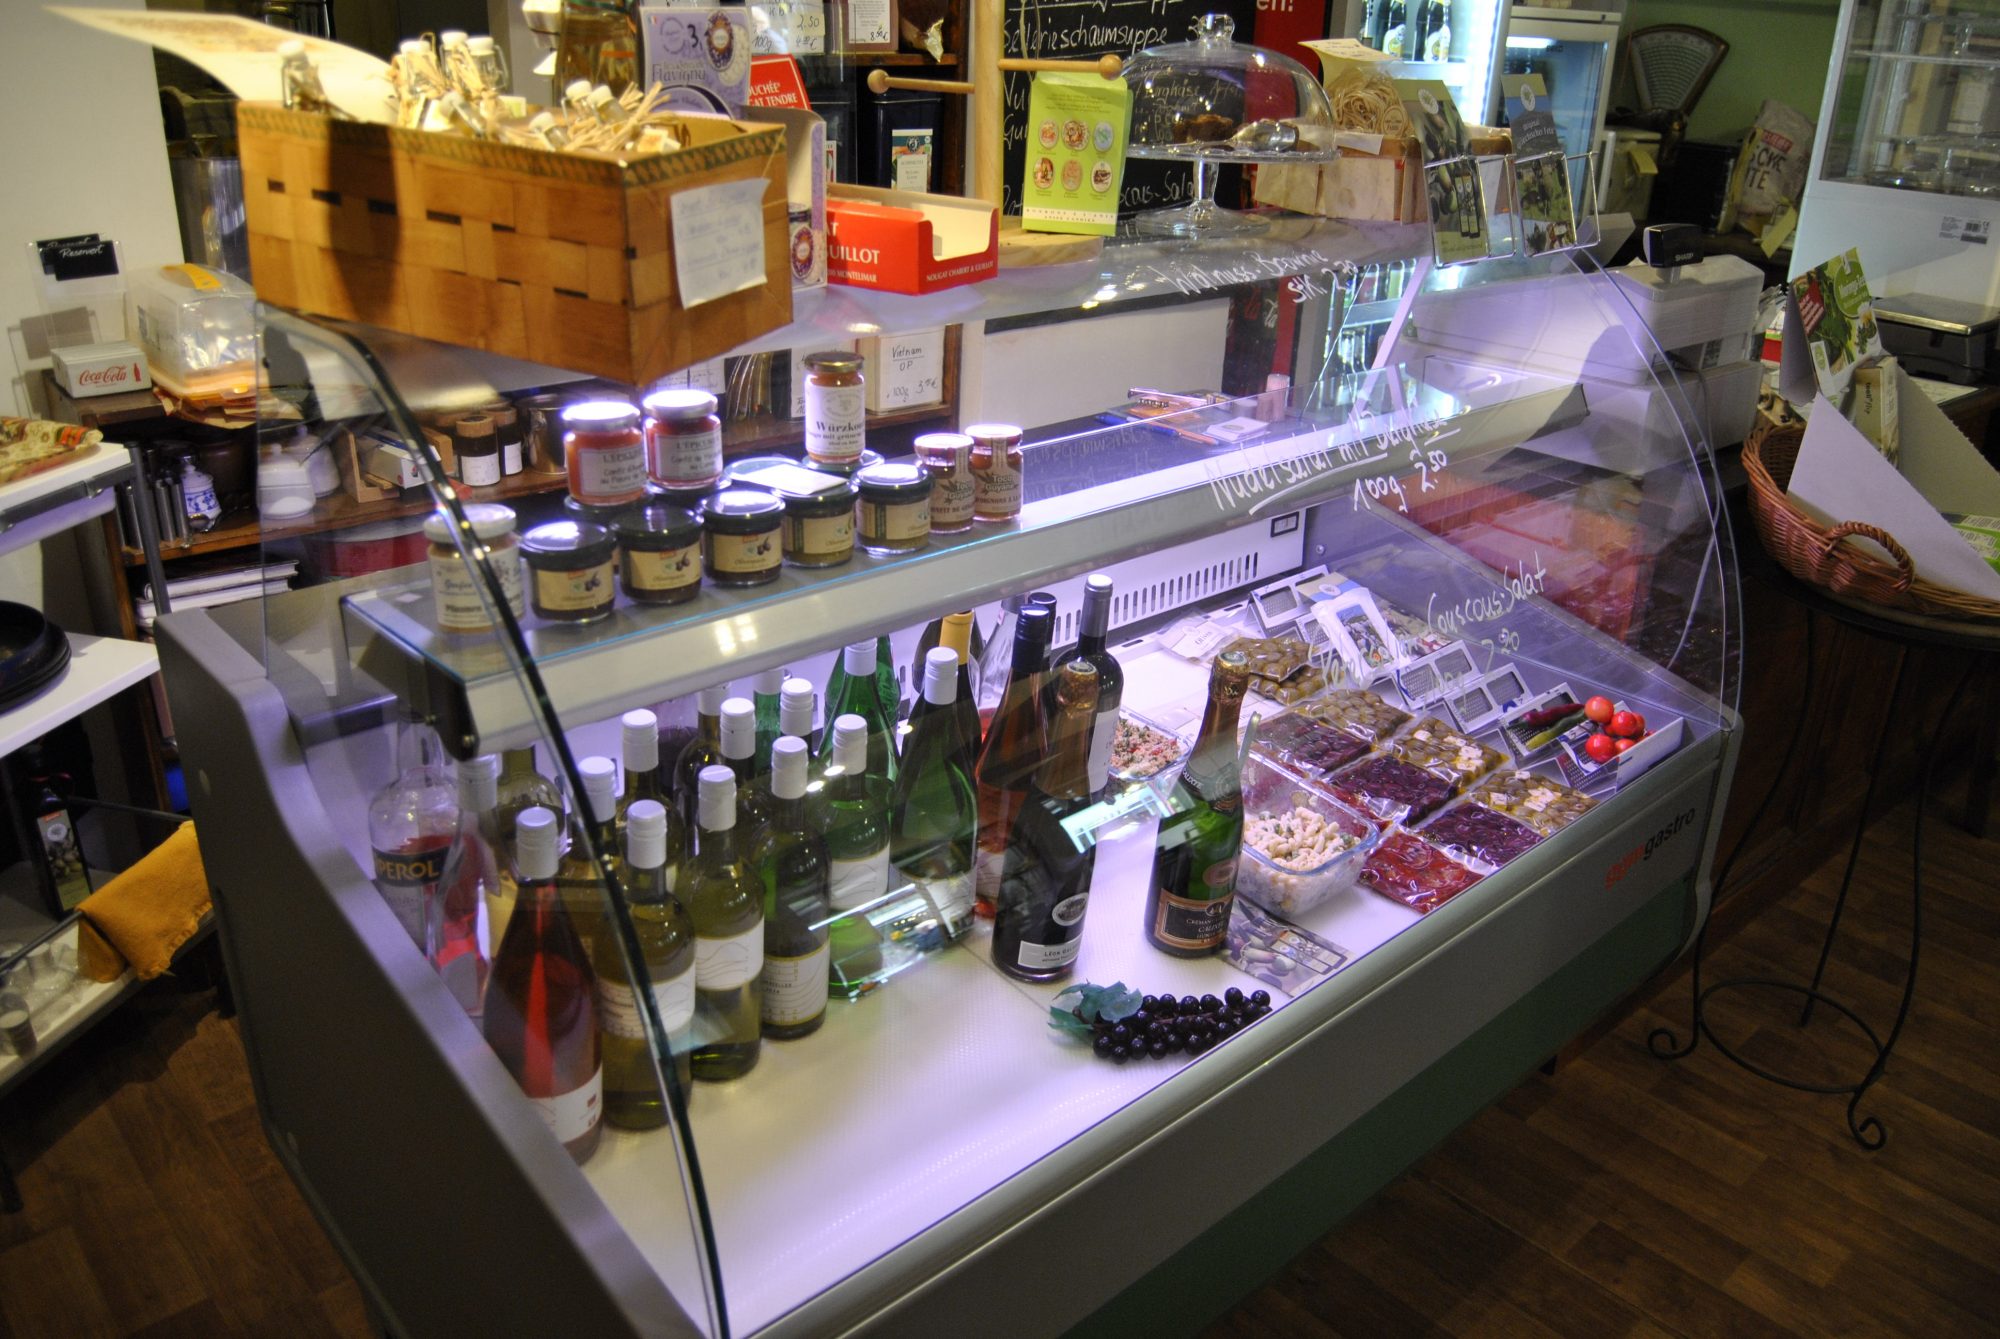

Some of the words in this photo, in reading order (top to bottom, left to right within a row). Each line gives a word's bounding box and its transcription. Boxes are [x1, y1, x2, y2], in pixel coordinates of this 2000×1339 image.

[828, 244, 881, 265] UILLOT
[79, 363, 127, 386] Coca-Cola
[376, 858, 440, 881] PEROL
